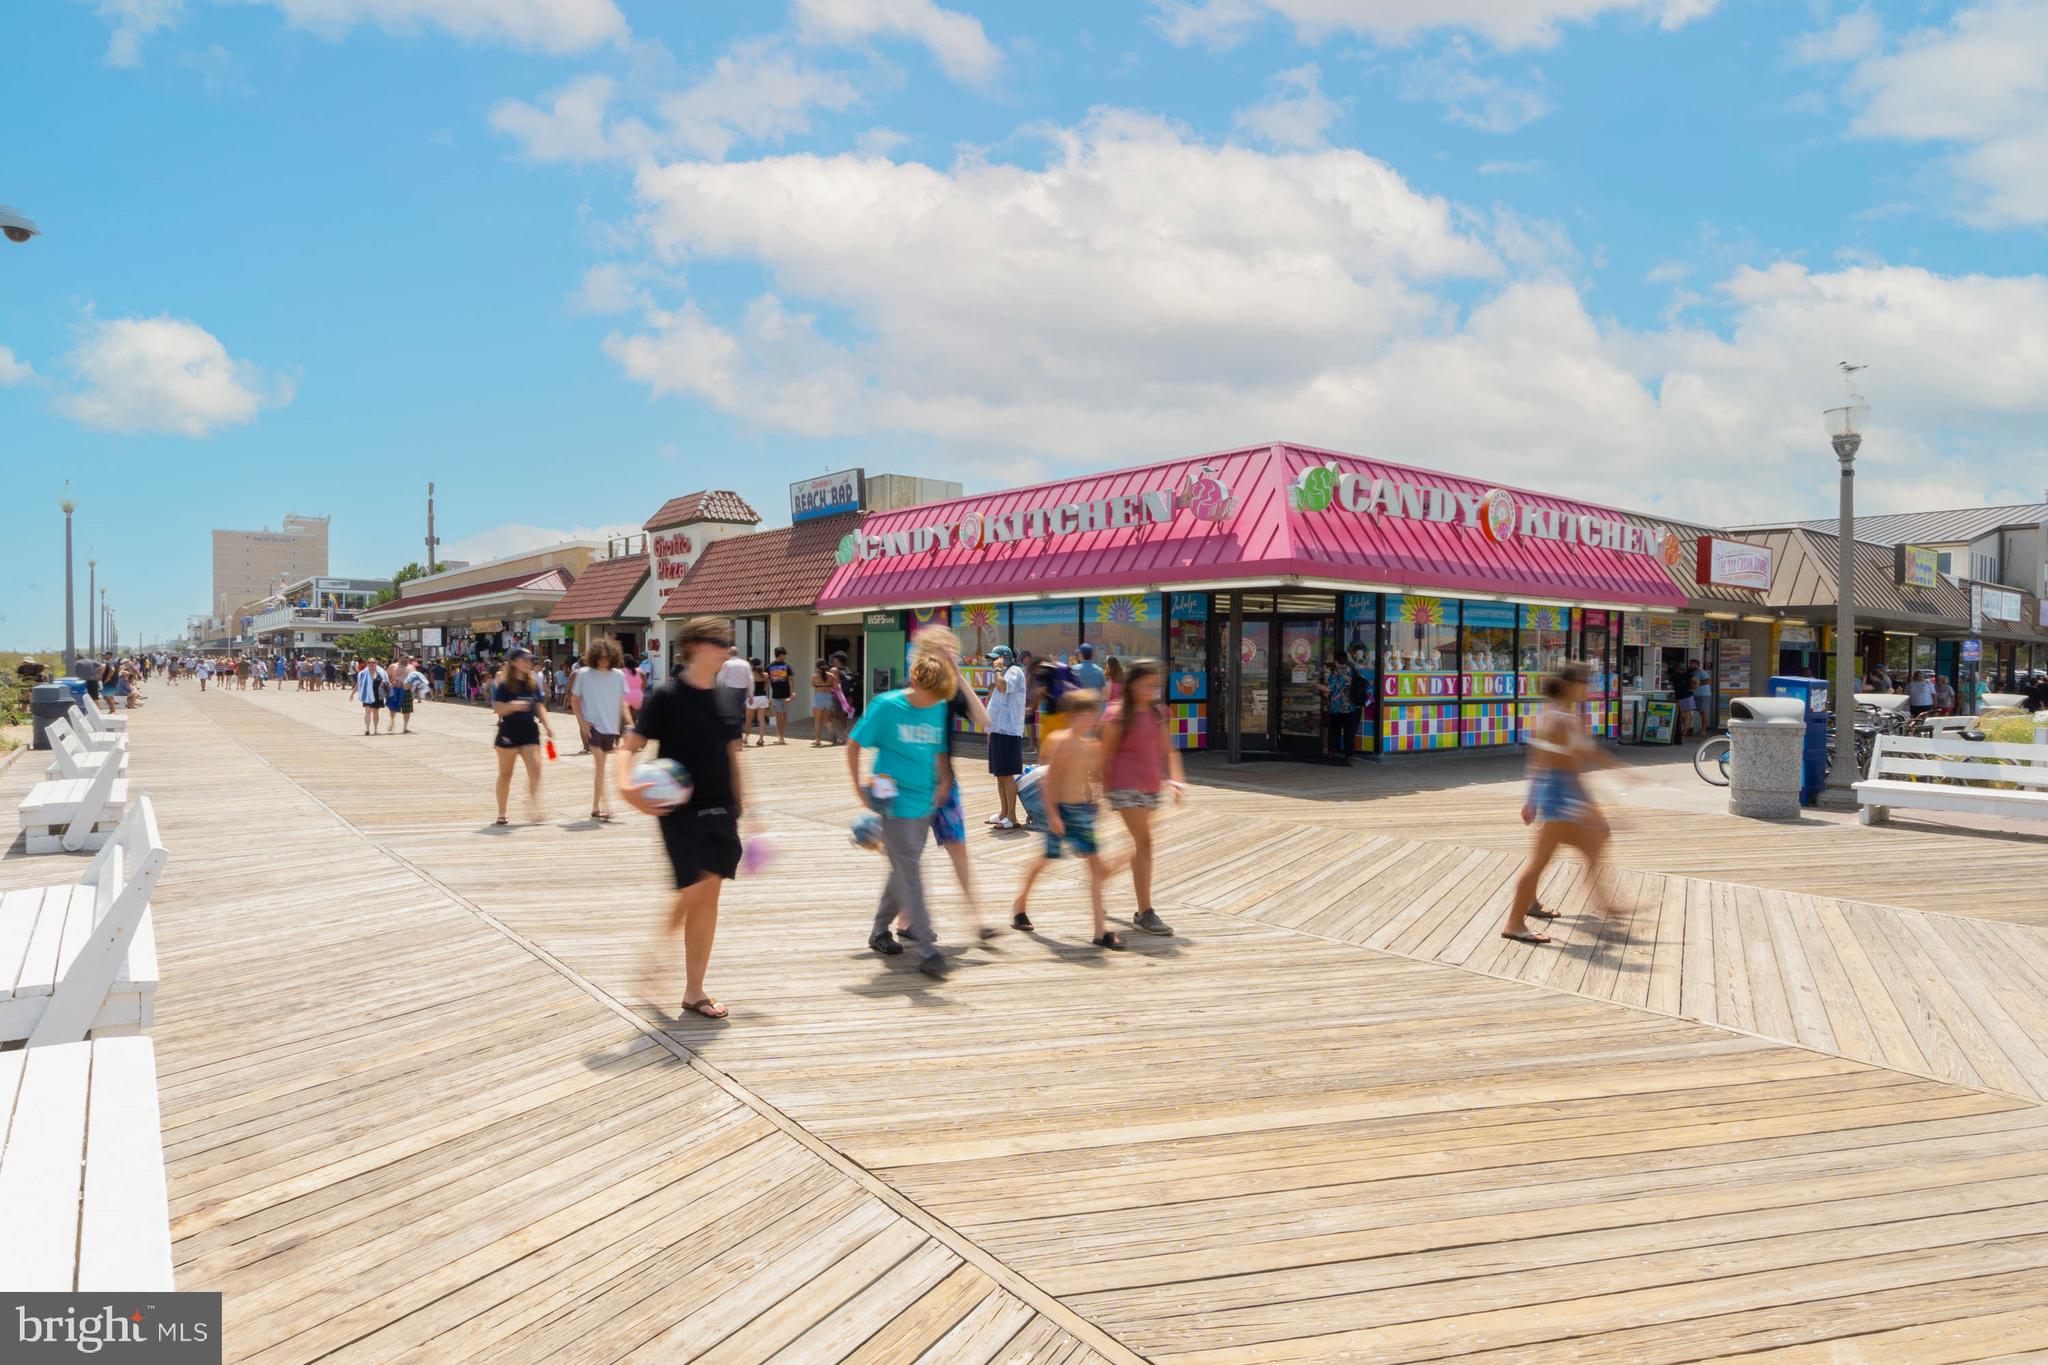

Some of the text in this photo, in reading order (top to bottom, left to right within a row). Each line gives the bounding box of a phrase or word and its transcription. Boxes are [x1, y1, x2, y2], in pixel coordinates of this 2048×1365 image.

[795, 483, 853, 512] BEACH BAR
[859, 520, 960, 561] CANDY
[983, 488, 1175, 545] KITCHEN
[1339, 473, 1484, 528] CANDY
[1519, 504, 1658, 556] KITCHEN
[657, 558, 688, 580] Pizza
[867, 614, 886, 625] WSFS
[1385, 676, 1457, 696] CANDY
[1462, 676, 1514, 697] FUDGE
